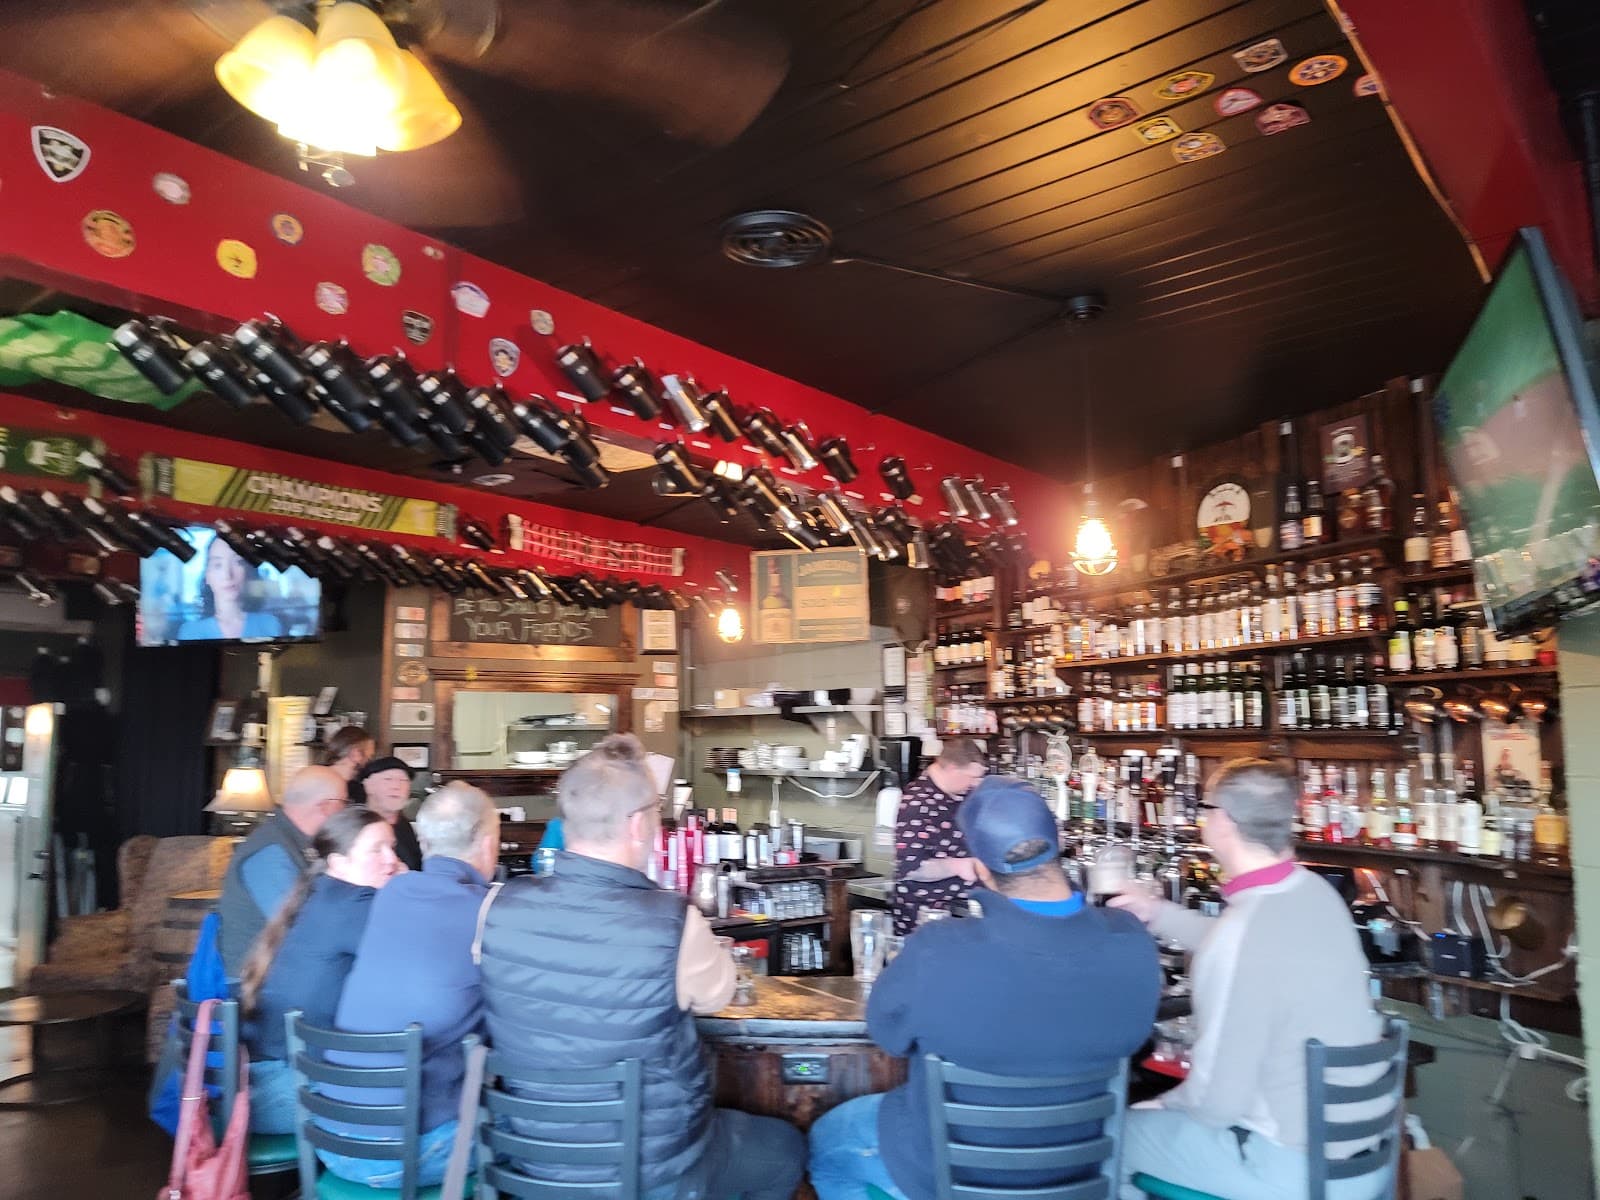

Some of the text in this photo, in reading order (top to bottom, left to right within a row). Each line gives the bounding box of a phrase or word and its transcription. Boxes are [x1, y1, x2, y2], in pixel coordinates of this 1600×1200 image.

[247, 475, 383, 512] CHAMPIONS
[453, 598, 475, 615] BE
[464, 616, 593, 643] YOUR FRIENDS
